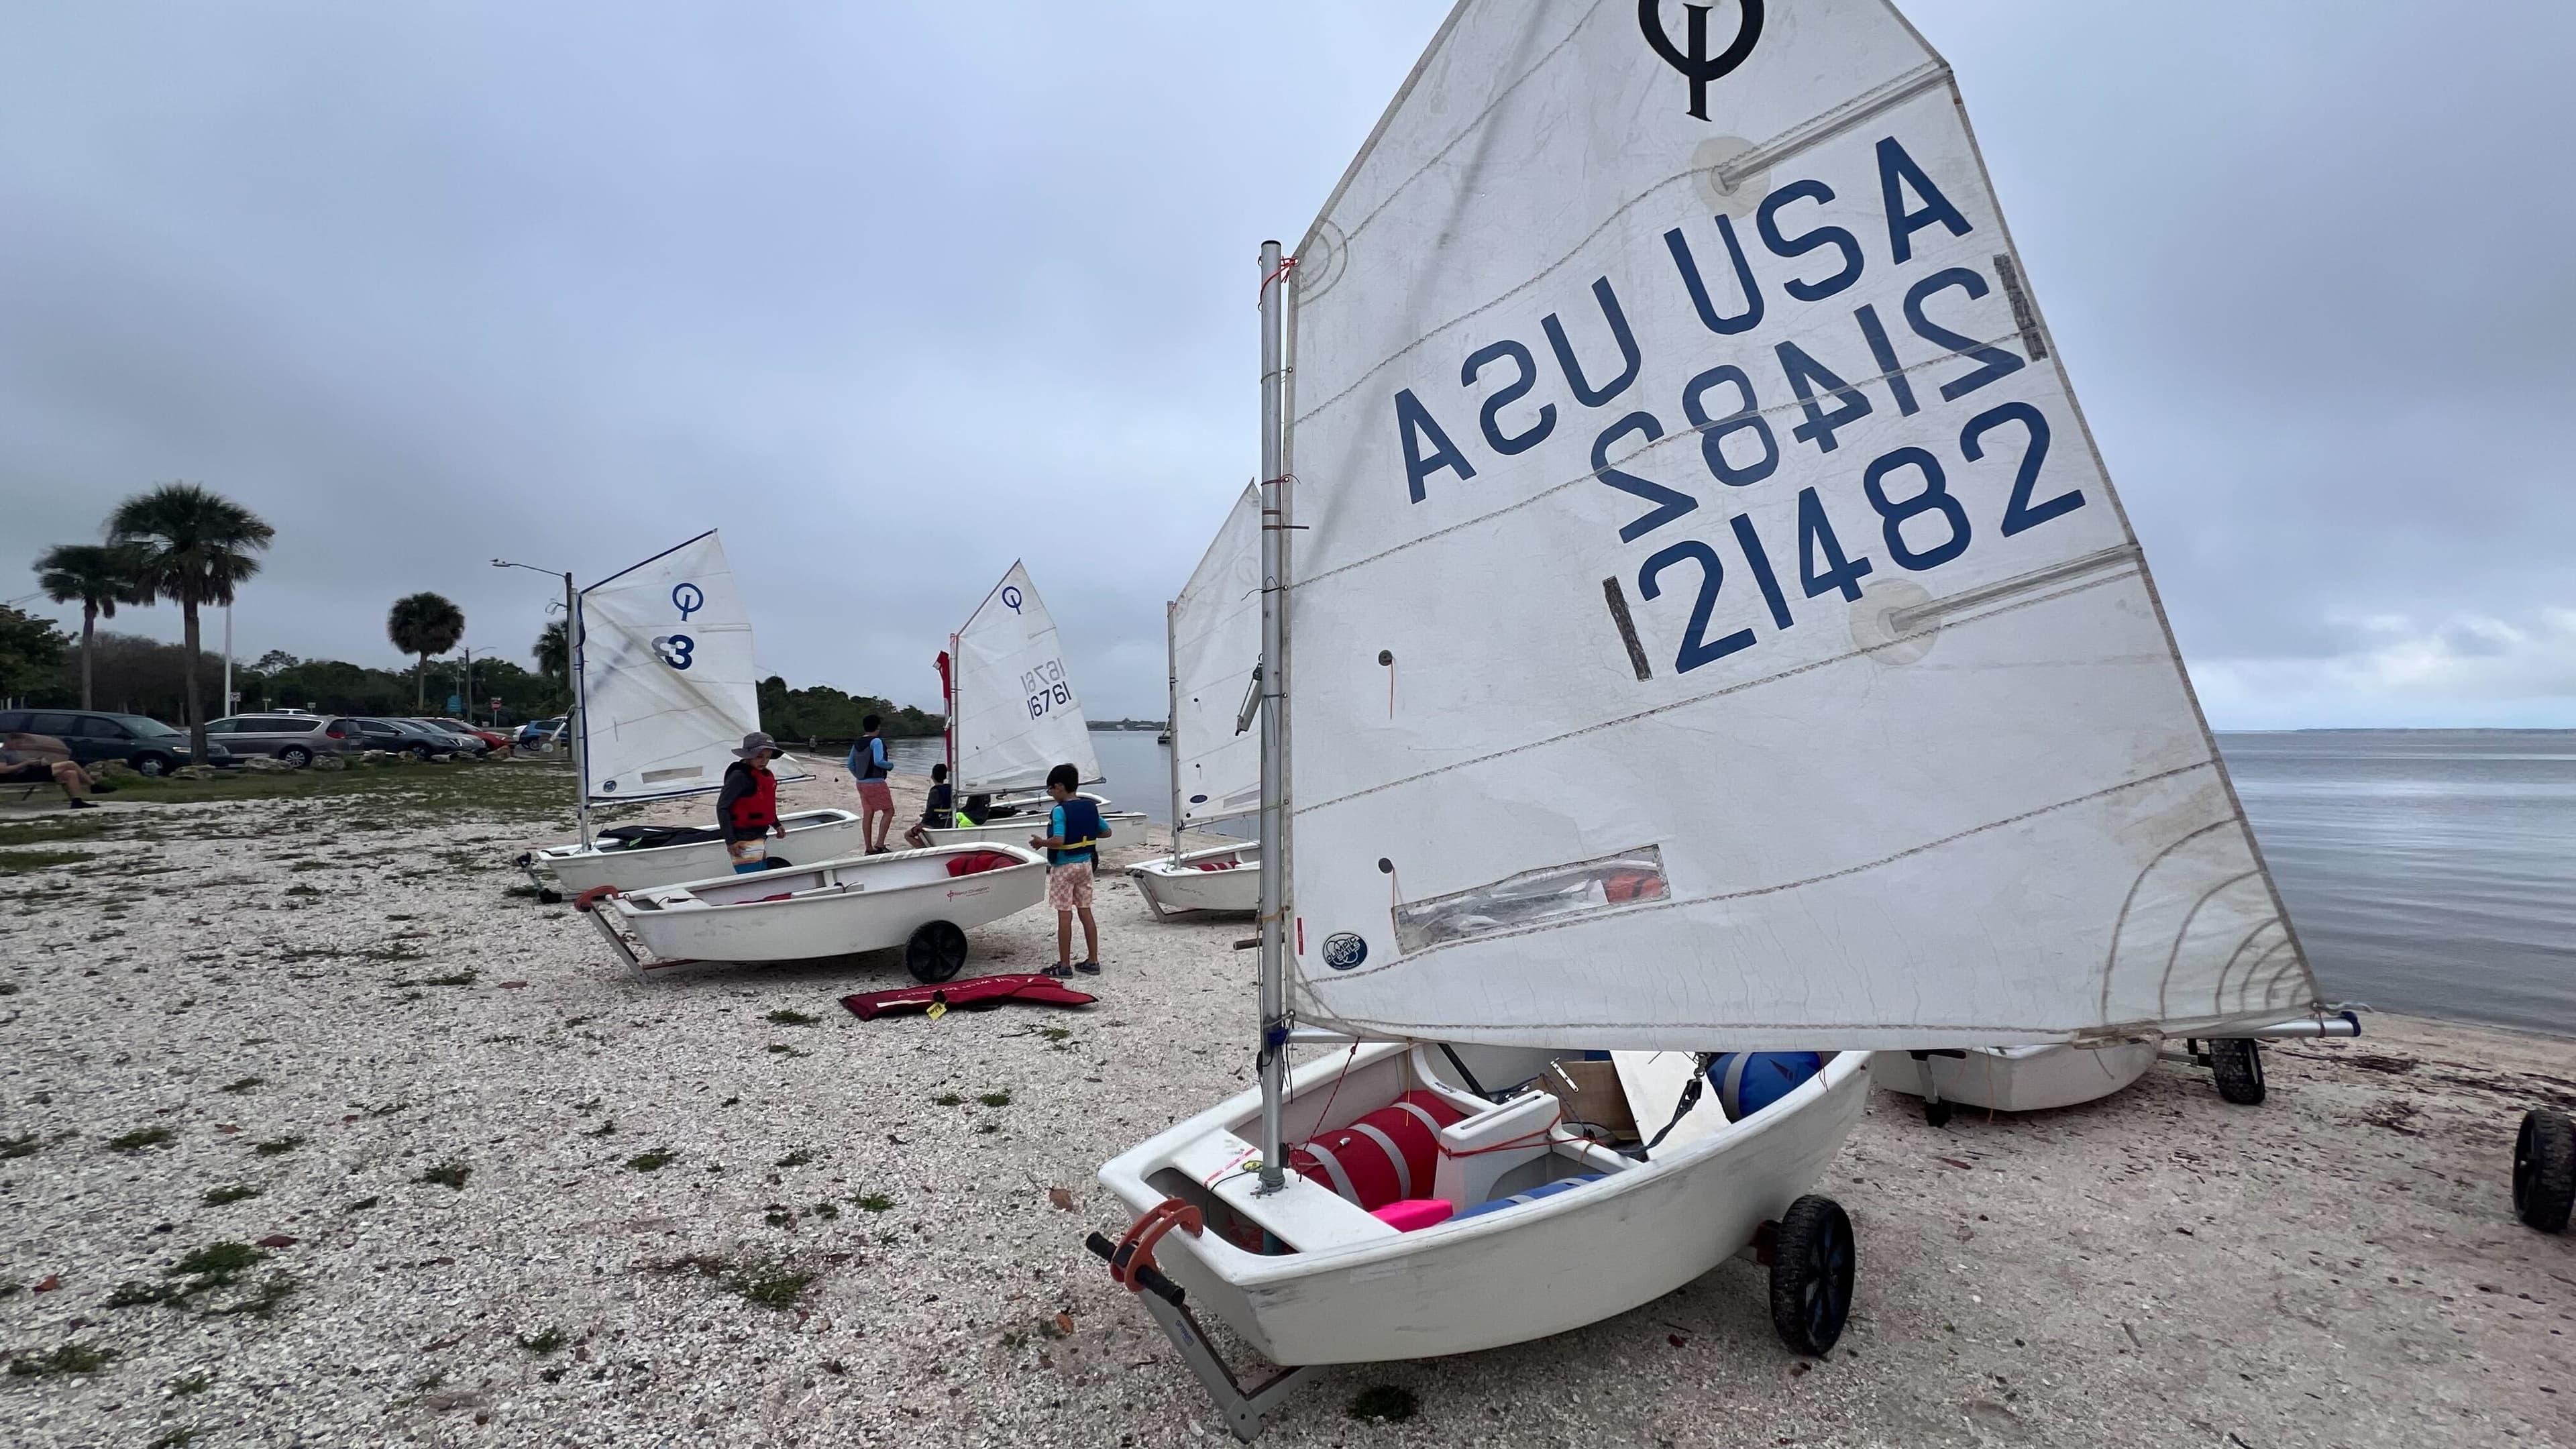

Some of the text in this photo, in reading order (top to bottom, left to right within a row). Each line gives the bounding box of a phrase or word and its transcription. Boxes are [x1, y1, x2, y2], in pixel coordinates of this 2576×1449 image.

[1664, 136, 1973, 335] USA
[665, 634, 695, 671] 3
[1027, 680, 1072, 720] 16761
[1336, 941, 1361, 961] SAILS
